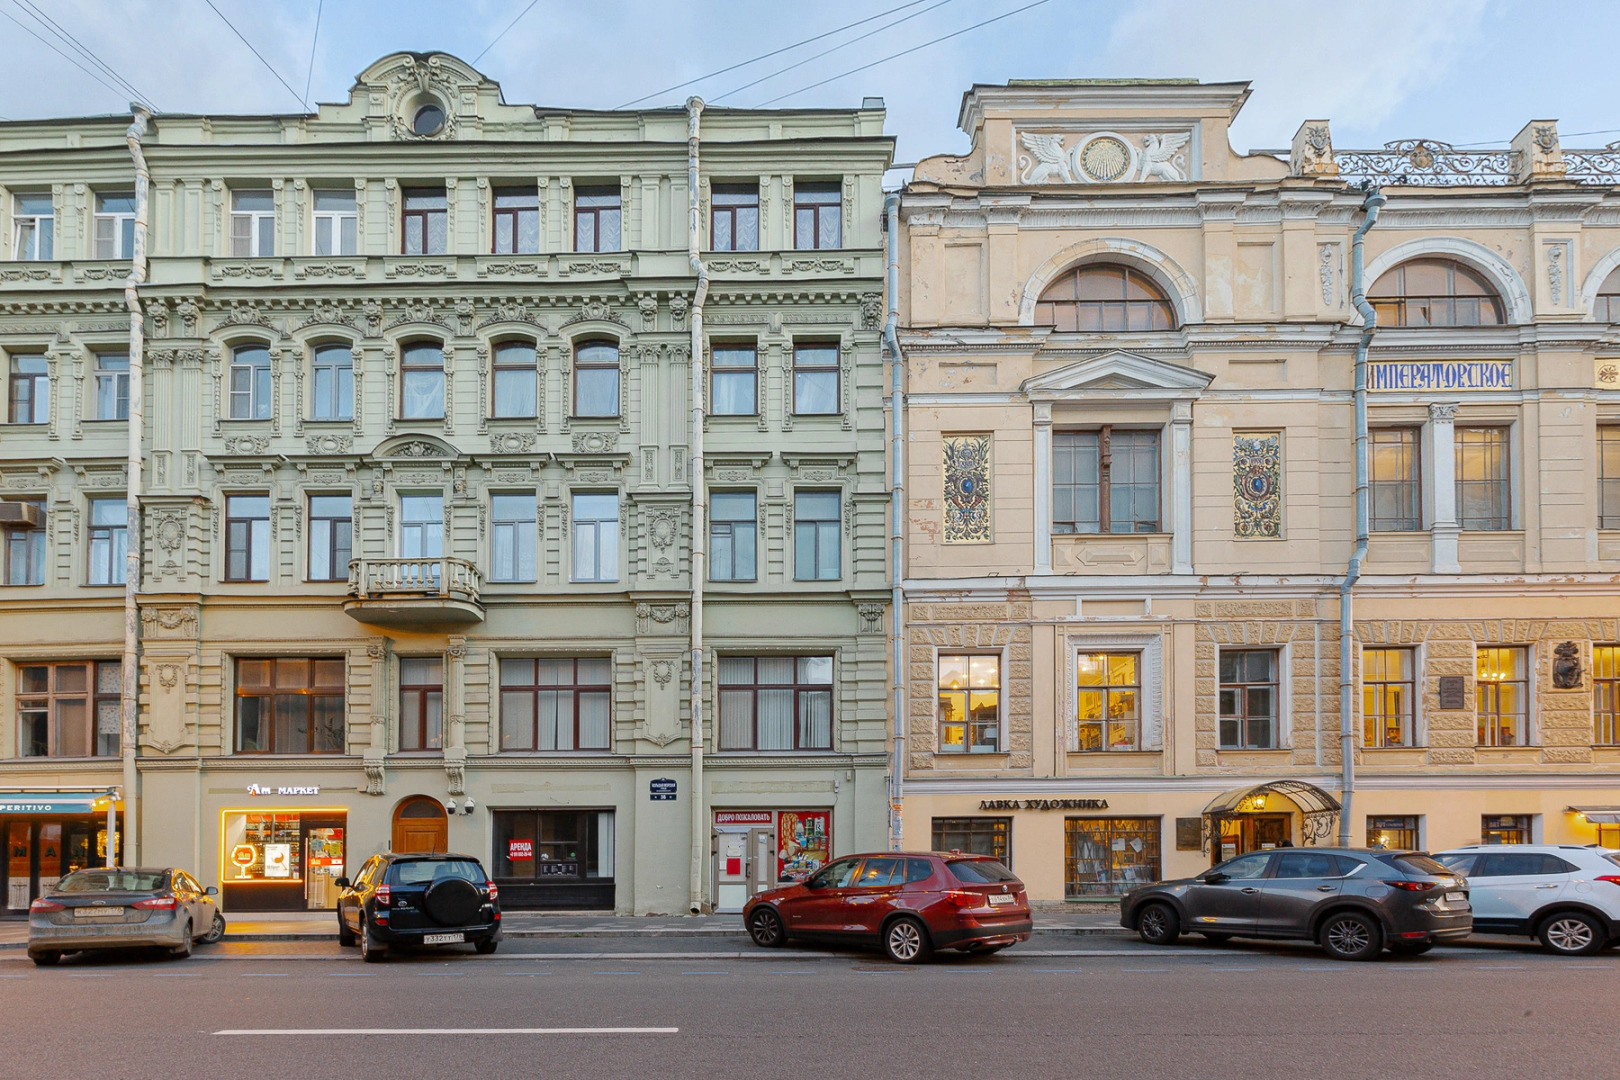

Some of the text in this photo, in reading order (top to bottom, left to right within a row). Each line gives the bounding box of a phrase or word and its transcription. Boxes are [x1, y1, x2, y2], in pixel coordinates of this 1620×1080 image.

[979, 799, 1109, 811] ЛАВКА ХУДОЖНИКА
[717, 813, 771, 823] ДОБРО ПОЖАЛОВАТЬ
[510, 842, 532, 852] АРЕНДА
